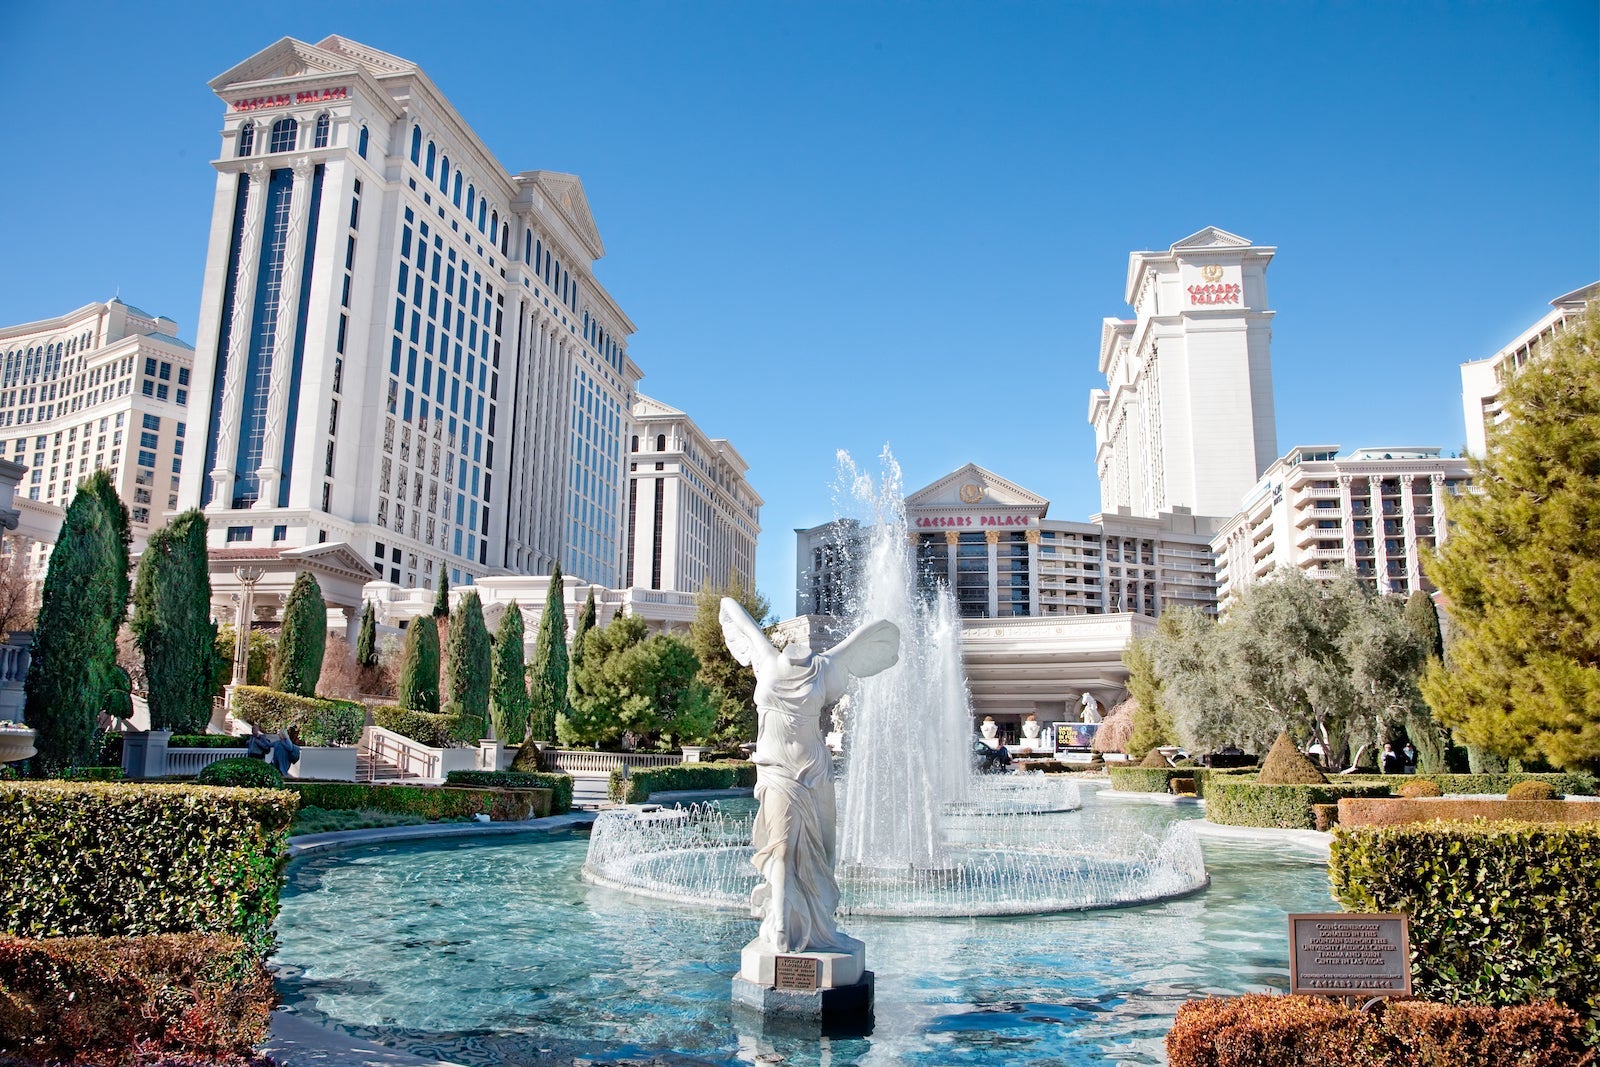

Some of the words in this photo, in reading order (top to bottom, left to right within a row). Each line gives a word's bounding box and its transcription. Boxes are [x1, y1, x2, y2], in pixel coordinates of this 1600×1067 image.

[232, 94, 290, 112] CAESARS
[296, 86, 347, 104] PALACE
[1187, 283, 1241, 295] CAESARS
[1191, 294, 1239, 305] PALACE
[915, 516, 972, 527] CAESARS
[980, 515, 1028, 526] PALACE
[1338, 923, 1380, 931] GENEROUSLY
[1320, 930, 1352, 938] DONATED
[1352, 930, 1360, 938] IN
[1361, 930, 1378, 938] THIS
[1311, 937, 1344, 945] FOUNTAIN
[1344, 937, 1372, 945] SUPPORT
[1373, 937, 1388, 945] THE
[1302, 943, 1339, 952] UNIVERSITY
[1370, 944, 1397, 952] CENTER
[1317, 951, 1345, 959] TRAUMA
[1346, 951, 1361, 959] AND
[1362, 951, 1382, 959] BURN
[1315, 958, 1340, 966] CENTER
[1341, 958, 1350, 966] IN
[1351, 958, 1363, 966] LAS
[1364, 958, 1385, 966] VEGAS
[1310, 980, 1352, 988] CAESARS
[1354, 980, 1392, 988] PALACE
